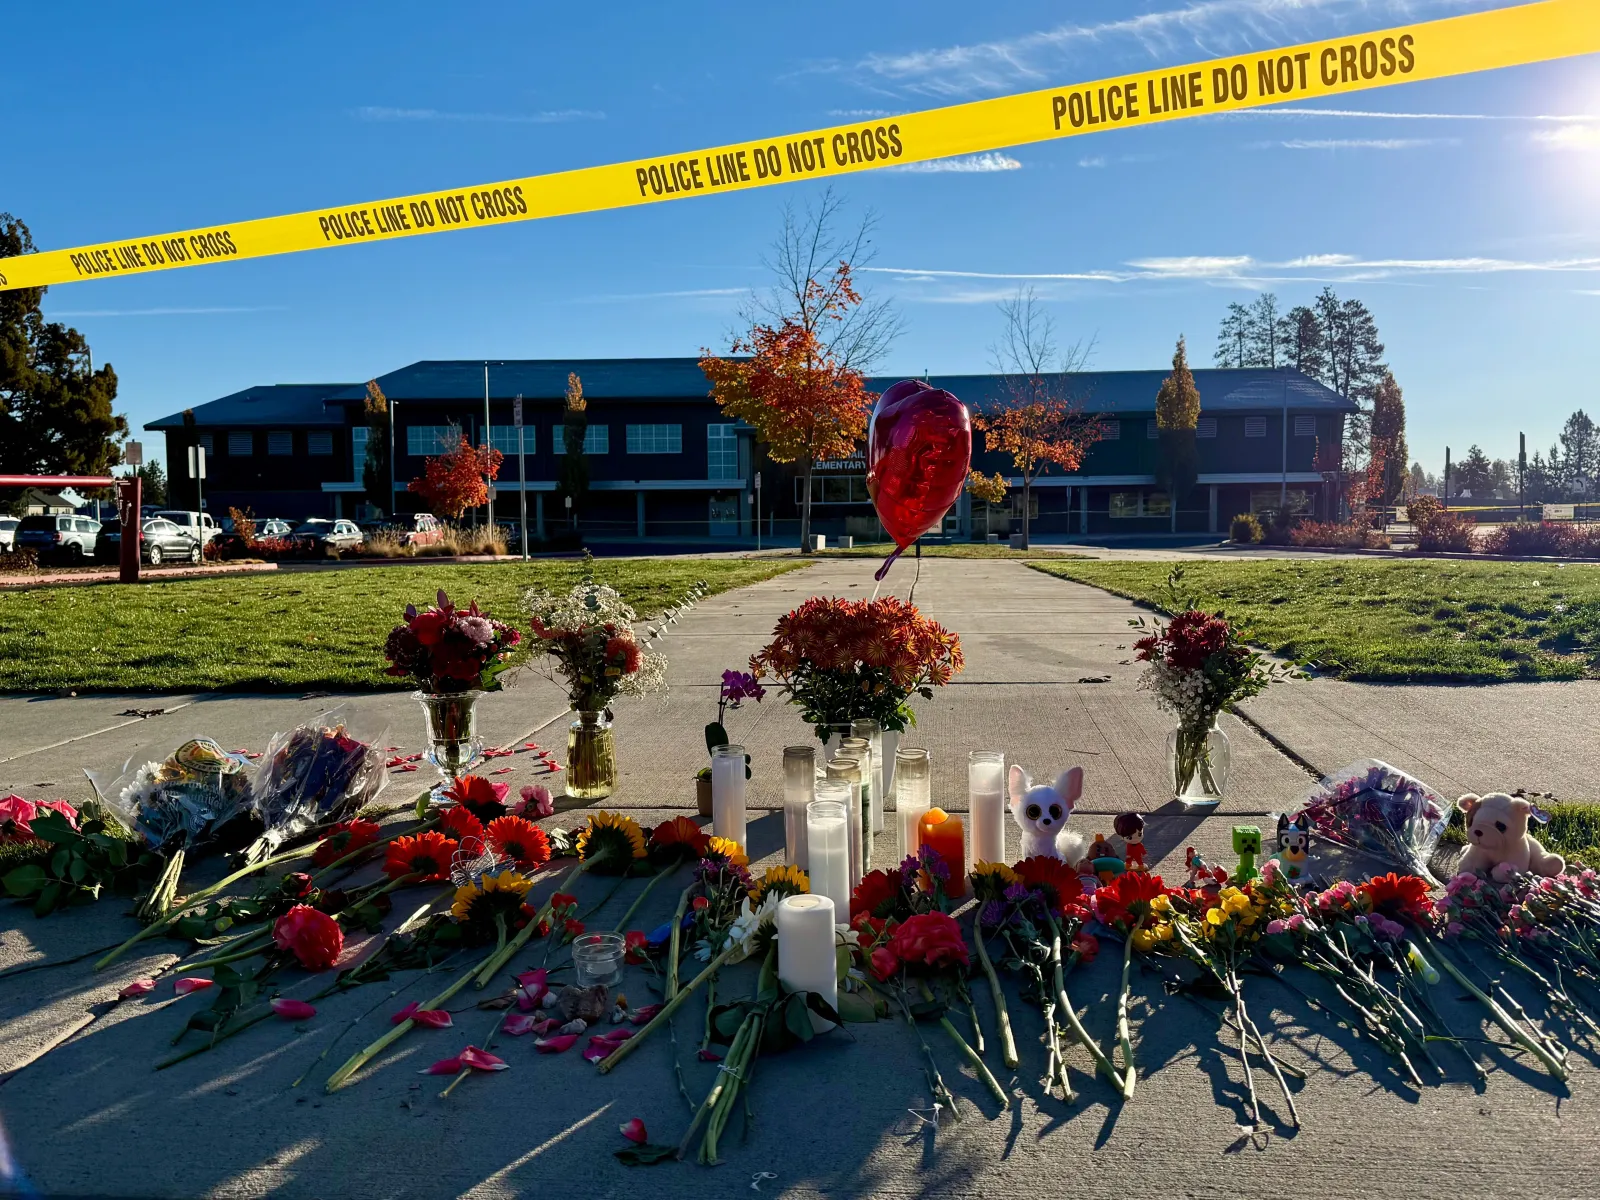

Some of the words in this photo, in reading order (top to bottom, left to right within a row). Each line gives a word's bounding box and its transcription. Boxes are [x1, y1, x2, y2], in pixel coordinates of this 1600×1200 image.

[1053, 83, 1139, 130] POLICE
[1148, 72, 1203, 114] LINE
[1213, 64, 1247, 103] DO
[1258, 53, 1310, 96] NOT
[1321, 35, 1414, 86] CROSS
[636, 159, 704, 196] POLICE
[706, 151, 750, 186] LINE
[754, 146, 781, 178] DO
[787, 138, 825, 173] NOT
[833, 124, 902, 166] CROSS
[319, 210, 375, 240] POLICE
[373, 205, 411, 233] LINE
[410, 201, 435, 228] DO
[435, 195, 469, 224] NOT
[471, 186, 527, 219] CROSS
[70, 250, 118, 275] POLICE
[113, 245, 146, 269] LINE
[142, 242, 165, 265] DO
[162, 238, 191, 262] NOT
[190, 231, 237, 258] CROSS
